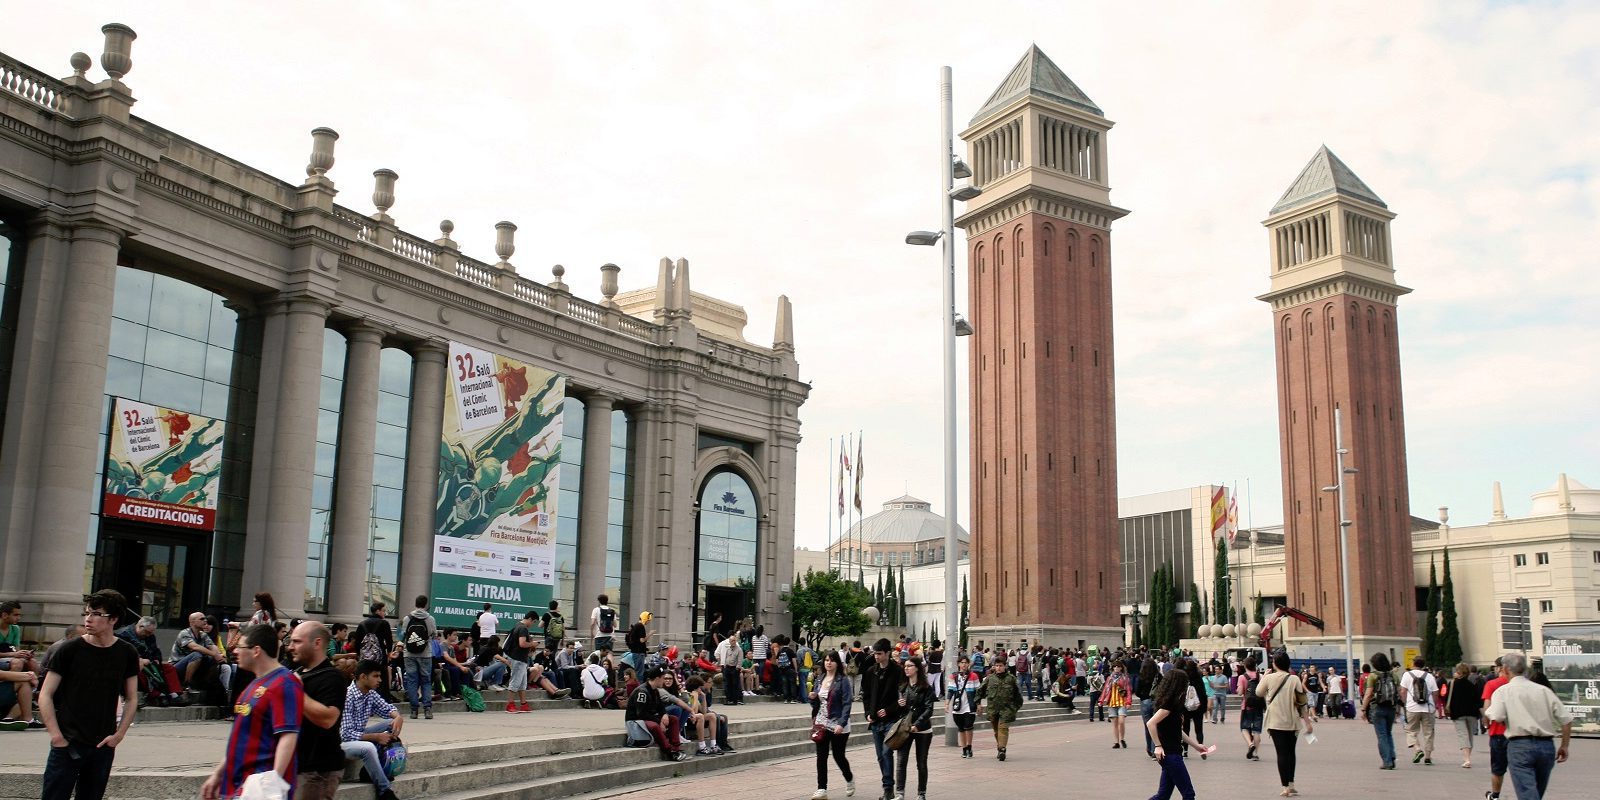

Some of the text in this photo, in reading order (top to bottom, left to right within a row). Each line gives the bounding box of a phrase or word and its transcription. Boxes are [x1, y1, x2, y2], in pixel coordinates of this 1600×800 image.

[455, 352, 491, 382] 32 Saló
[460, 378, 493, 394] Internacional
[462, 397, 472, 407] del
[465, 404, 498, 420] de Barcelona
[124, 410, 154, 428] 32 Saló
[128, 426, 156, 436] Internacional
[138, 443, 160, 453] Barcelona
[118, 504, 204, 524] ACREDITACIONS
[490, 530, 500, 539] Fira
[501, 531, 526, 543] Barcelona
[467, 582, 521, 602] ENTRADA
[445, 606, 465, 616] MARIA
[1546, 644, 1582, 654] MONTJUÏC
[637, 692, 646, 703] R
